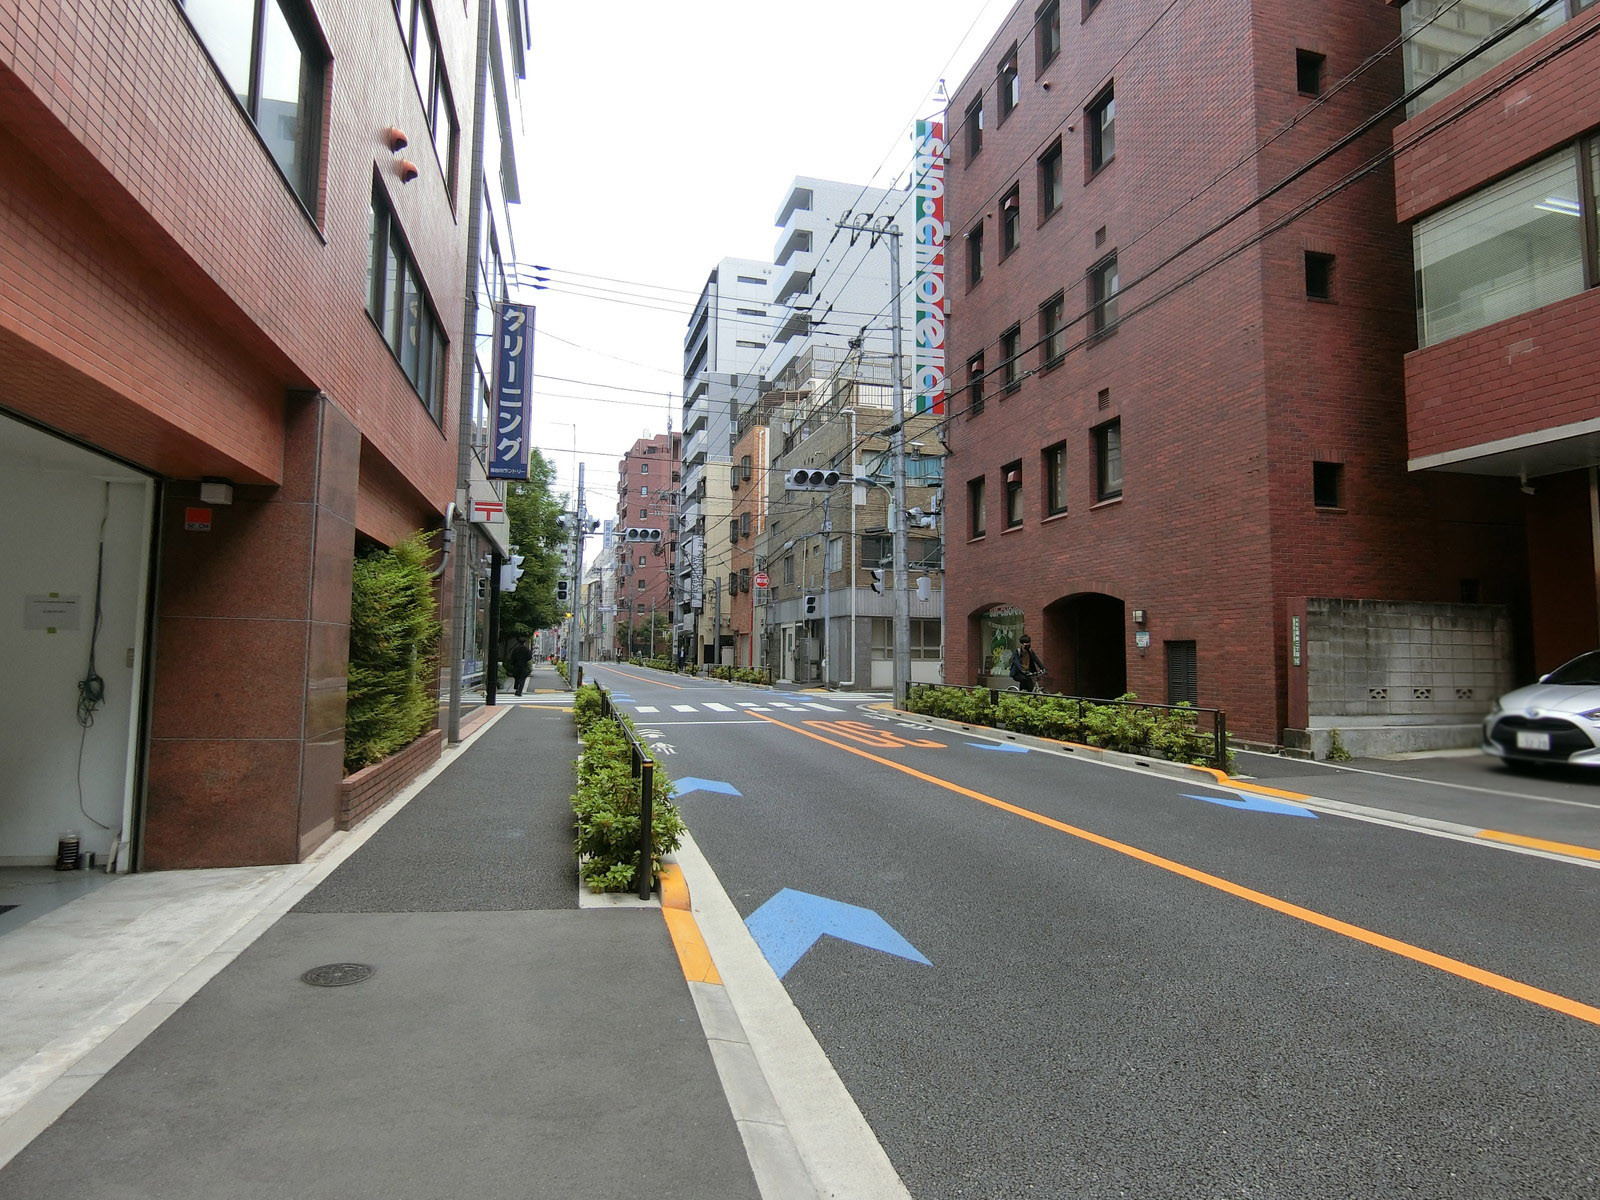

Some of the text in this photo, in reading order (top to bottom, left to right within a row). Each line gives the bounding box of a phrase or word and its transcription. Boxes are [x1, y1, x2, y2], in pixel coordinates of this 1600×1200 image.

[497, 308, 525, 461] クリーニング
